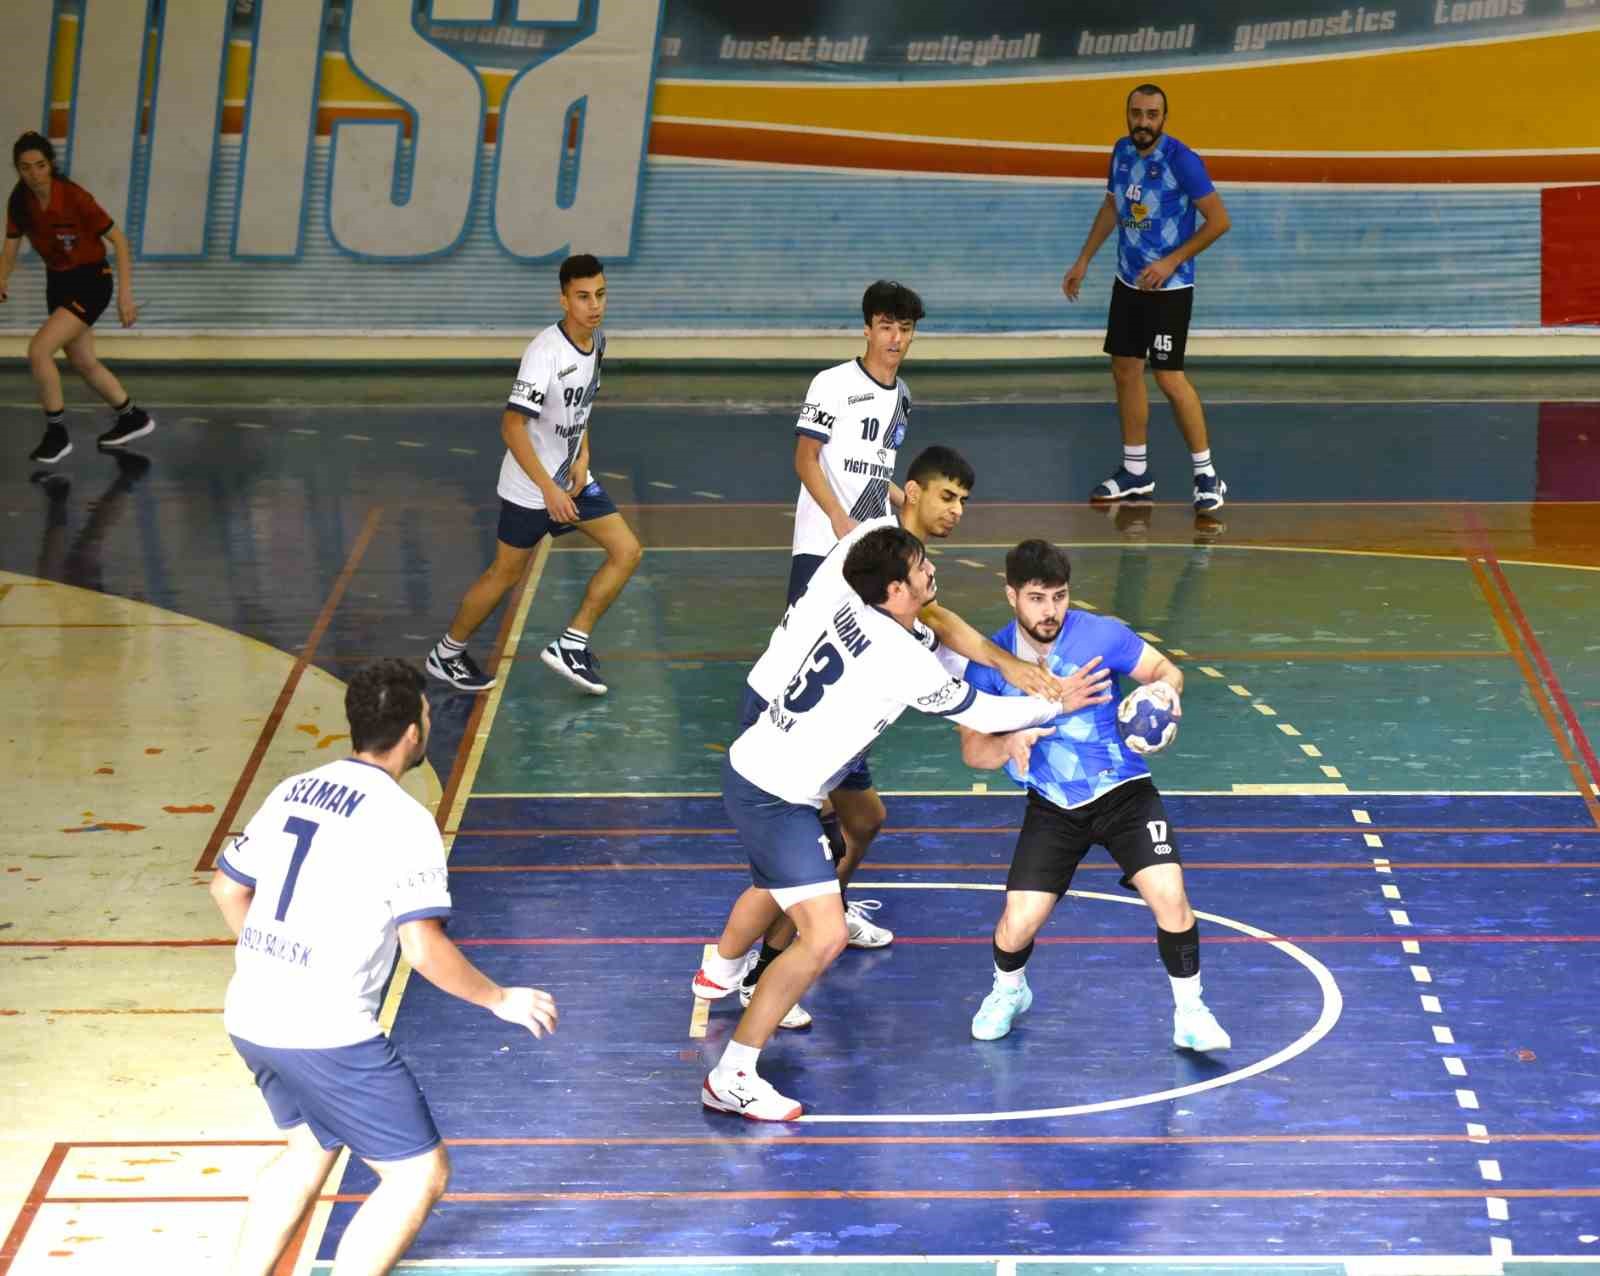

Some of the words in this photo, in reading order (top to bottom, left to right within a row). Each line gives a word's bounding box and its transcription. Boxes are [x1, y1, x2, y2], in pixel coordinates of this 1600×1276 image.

[1078, 24, 1195, 56] handball
[1233, 7, 1396, 53] gymnastics
[719, 35, 869, 64] basketball
[906, 33, 1041, 67] volleyball
[1126, 184, 1142, 201] 45
[1154, 334, 1172, 351] 45
[564, 386, 584, 408] 99
[860, 417, 880, 442] 10
[284, 778, 366, 819] SELMAN
[1146, 820, 1167, 843] 17
[275, 815, 320, 923] 7
